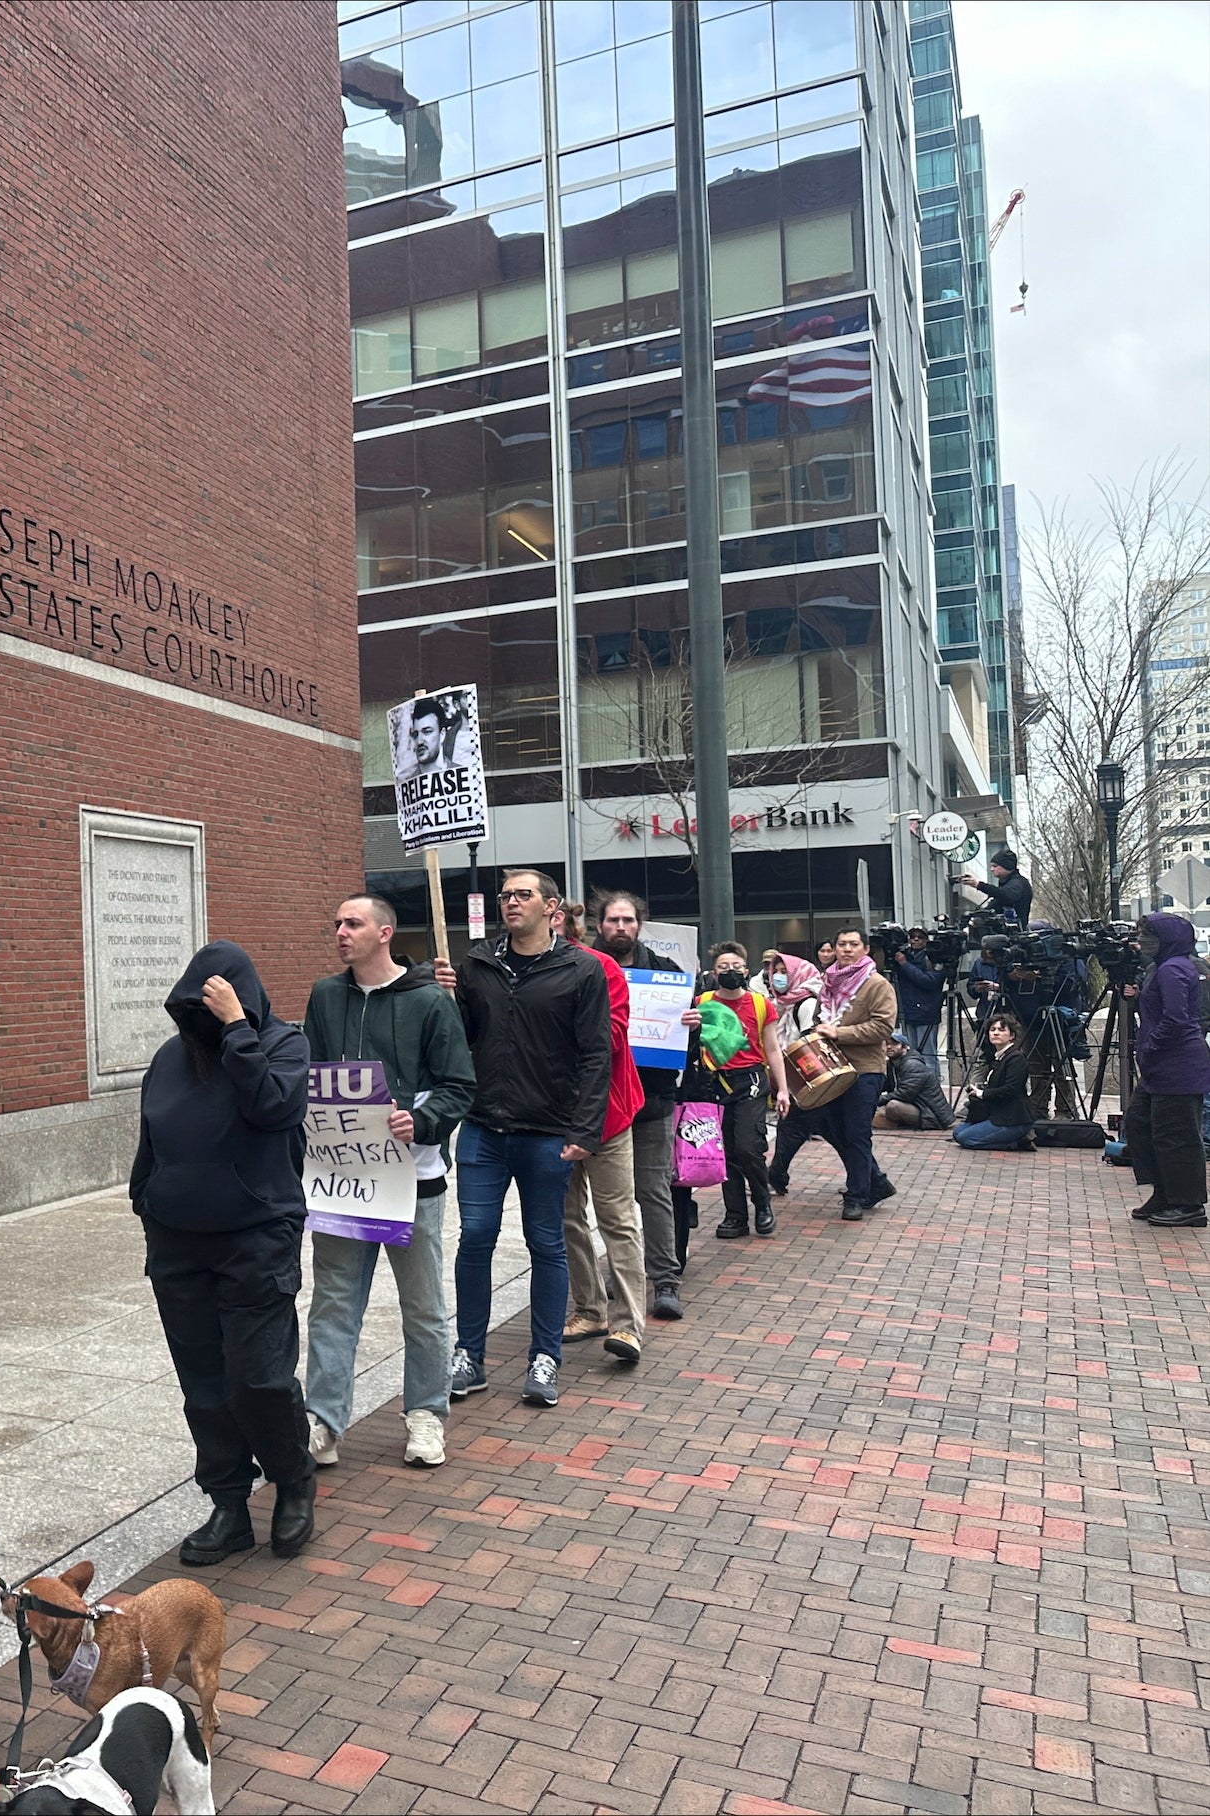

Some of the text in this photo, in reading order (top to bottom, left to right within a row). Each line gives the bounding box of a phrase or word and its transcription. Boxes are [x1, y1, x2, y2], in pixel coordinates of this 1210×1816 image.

[115, 558, 249, 646] MOAKLEY
[0, 572, 123, 654] STATES
[143, 626, 318, 717] COURTHOUSE
[401, 767, 470, 807] RELEASE
[404, 795, 472, 819] MAHMOUD
[651, 801, 854, 837] Leaer Bank
[404, 807, 473, 835] KHALIL!
[453, 829, 484, 838] Liberation
[927, 825, 964, 833] Leader
[932, 834, 960, 842] Bank
[652, 972, 687, 985] ACLU
[639, 990, 683, 1005] FREE
[311, 1172, 378, 1202] NOW
